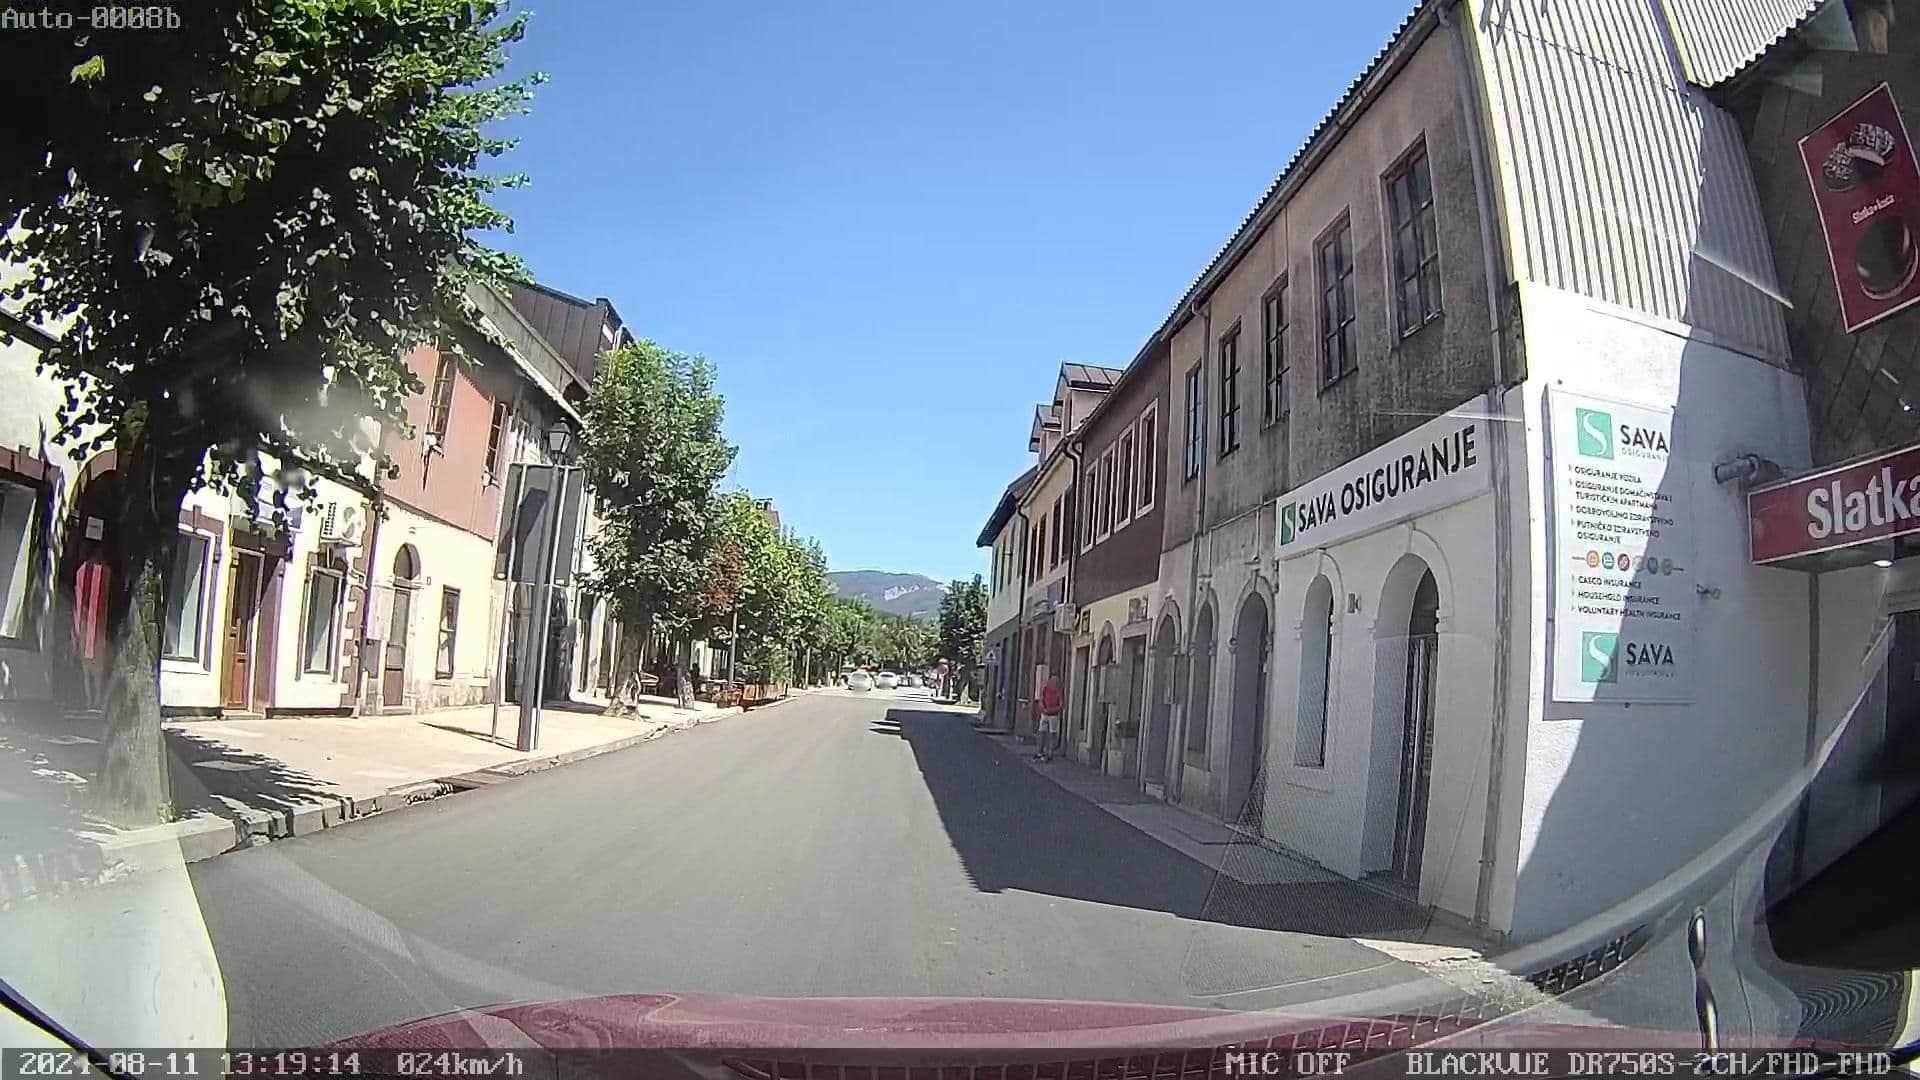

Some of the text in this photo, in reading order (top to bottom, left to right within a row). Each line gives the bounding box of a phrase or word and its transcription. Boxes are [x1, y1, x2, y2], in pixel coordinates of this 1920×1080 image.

[1620, 424, 1669, 453] SAVA
[1298, 491, 1337, 533] SAVA
[1341, 424, 1478, 516] OSIGURANJE
[1578, 575, 1642, 588] CASCO INSURANCE
[1578, 591, 1621, 601] HOUSEHOLD
[1578, 604, 1618, 615] VOLUNTARY
[1619, 608, 1645, 617] HEALTH
[1626, 642, 1674, 665] SAVA
